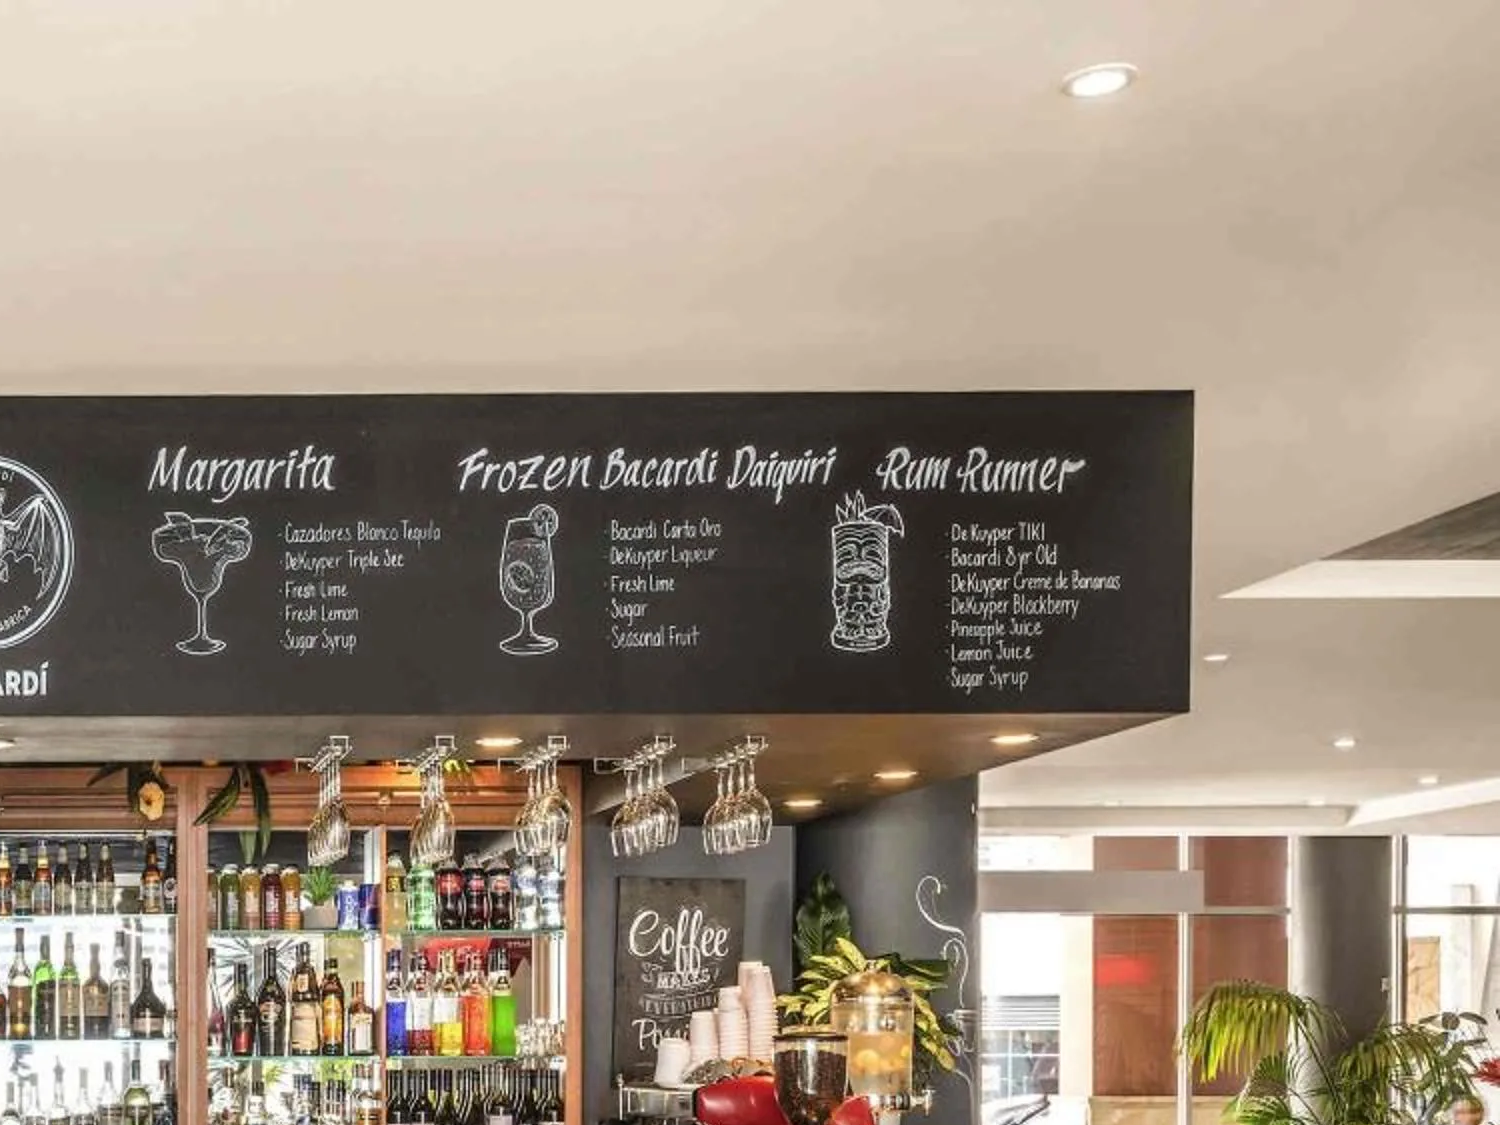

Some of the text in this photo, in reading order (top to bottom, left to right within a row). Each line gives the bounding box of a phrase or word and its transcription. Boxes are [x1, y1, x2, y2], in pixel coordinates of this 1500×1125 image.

[147, 445, 336, 503] Margarita
[457, 444, 838, 504] Frozen Bacardi Daiquiri
[876, 446, 1087, 494] Rum Runner
[285, 522, 350, 544] Cazadores
[401, 519, 442, 548] Tequila
[611, 516, 722, 541] Bacardi Carta Oro
[1017, 522, 1045, 541] TIKI
[348, 549, 380, 574] Triple
[383, 549, 405, 568] Sec
[671, 545, 719, 569] Liqueur
[951, 548, 1001, 567] Bacardi
[1035, 544, 1058, 565] Old
[285, 581, 349, 600] Fresh Lime
[611, 573, 676, 592] Fresh Lime
[1055, 569, 1069, 589] de
[1071, 569, 1121, 591] Bananas
[285, 605, 359, 622] Fresh Lemon
[611, 597, 649, 627] Sugar
[1013, 594, 1079, 620] Blackberry
[284, 628, 357, 656] Sugar Syrup
[611, 624, 701, 649] Seasonal Fruit
[951, 618, 1044, 645] Pineapple Juice
[951, 639, 1034, 662] Lemon Juice
[951, 665, 1029, 695] Sugar Syrup
[629, 908, 731, 976] Coffee
